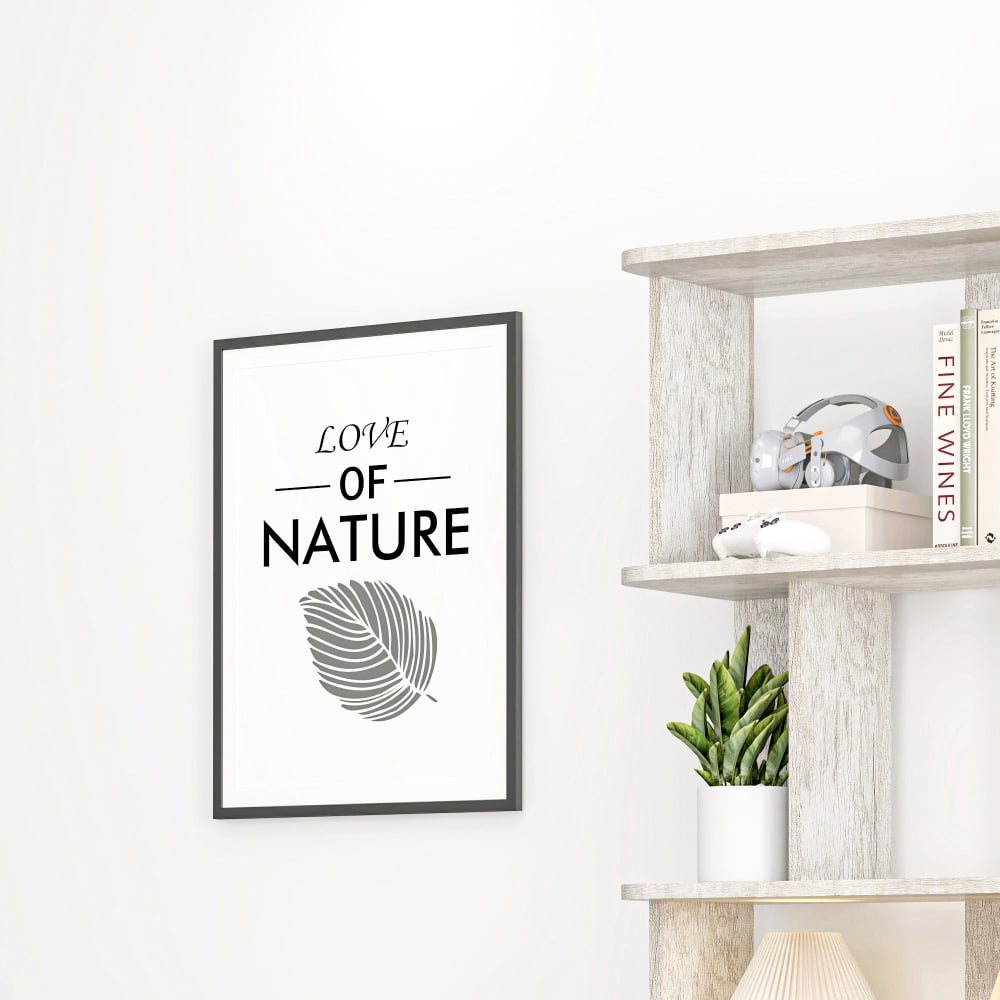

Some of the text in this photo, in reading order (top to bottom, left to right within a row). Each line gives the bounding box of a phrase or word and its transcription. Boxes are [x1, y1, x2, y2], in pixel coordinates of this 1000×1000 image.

[937, 355, 955, 417] FINE
[989, 380, 997, 408] Knitting
[314, 416, 410, 454] LOVE
[962, 385, 971, 474] FRANK LLOYD WRIGHT
[339, 464, 388, 501] OF
[937, 429, 955, 522] WINES
[263, 506, 470, 568] NATURE
